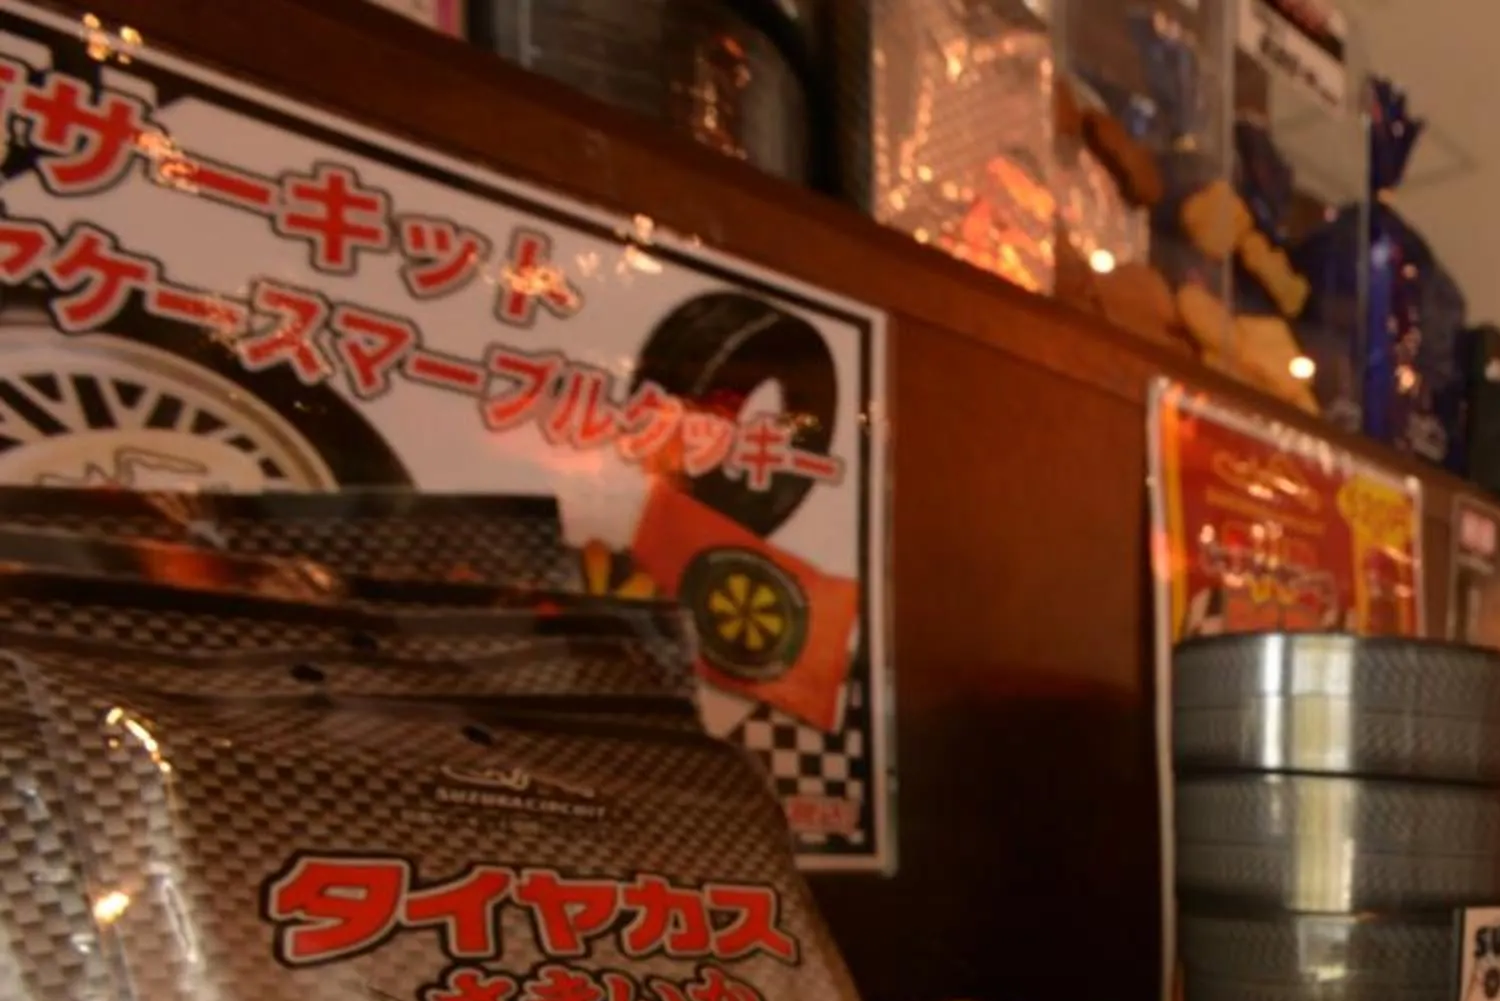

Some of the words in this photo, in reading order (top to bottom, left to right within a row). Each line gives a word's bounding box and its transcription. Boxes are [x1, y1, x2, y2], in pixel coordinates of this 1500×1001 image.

[0, 62, 584, 328] サーキット
[262, 852, 800, 965] タイヤカス
